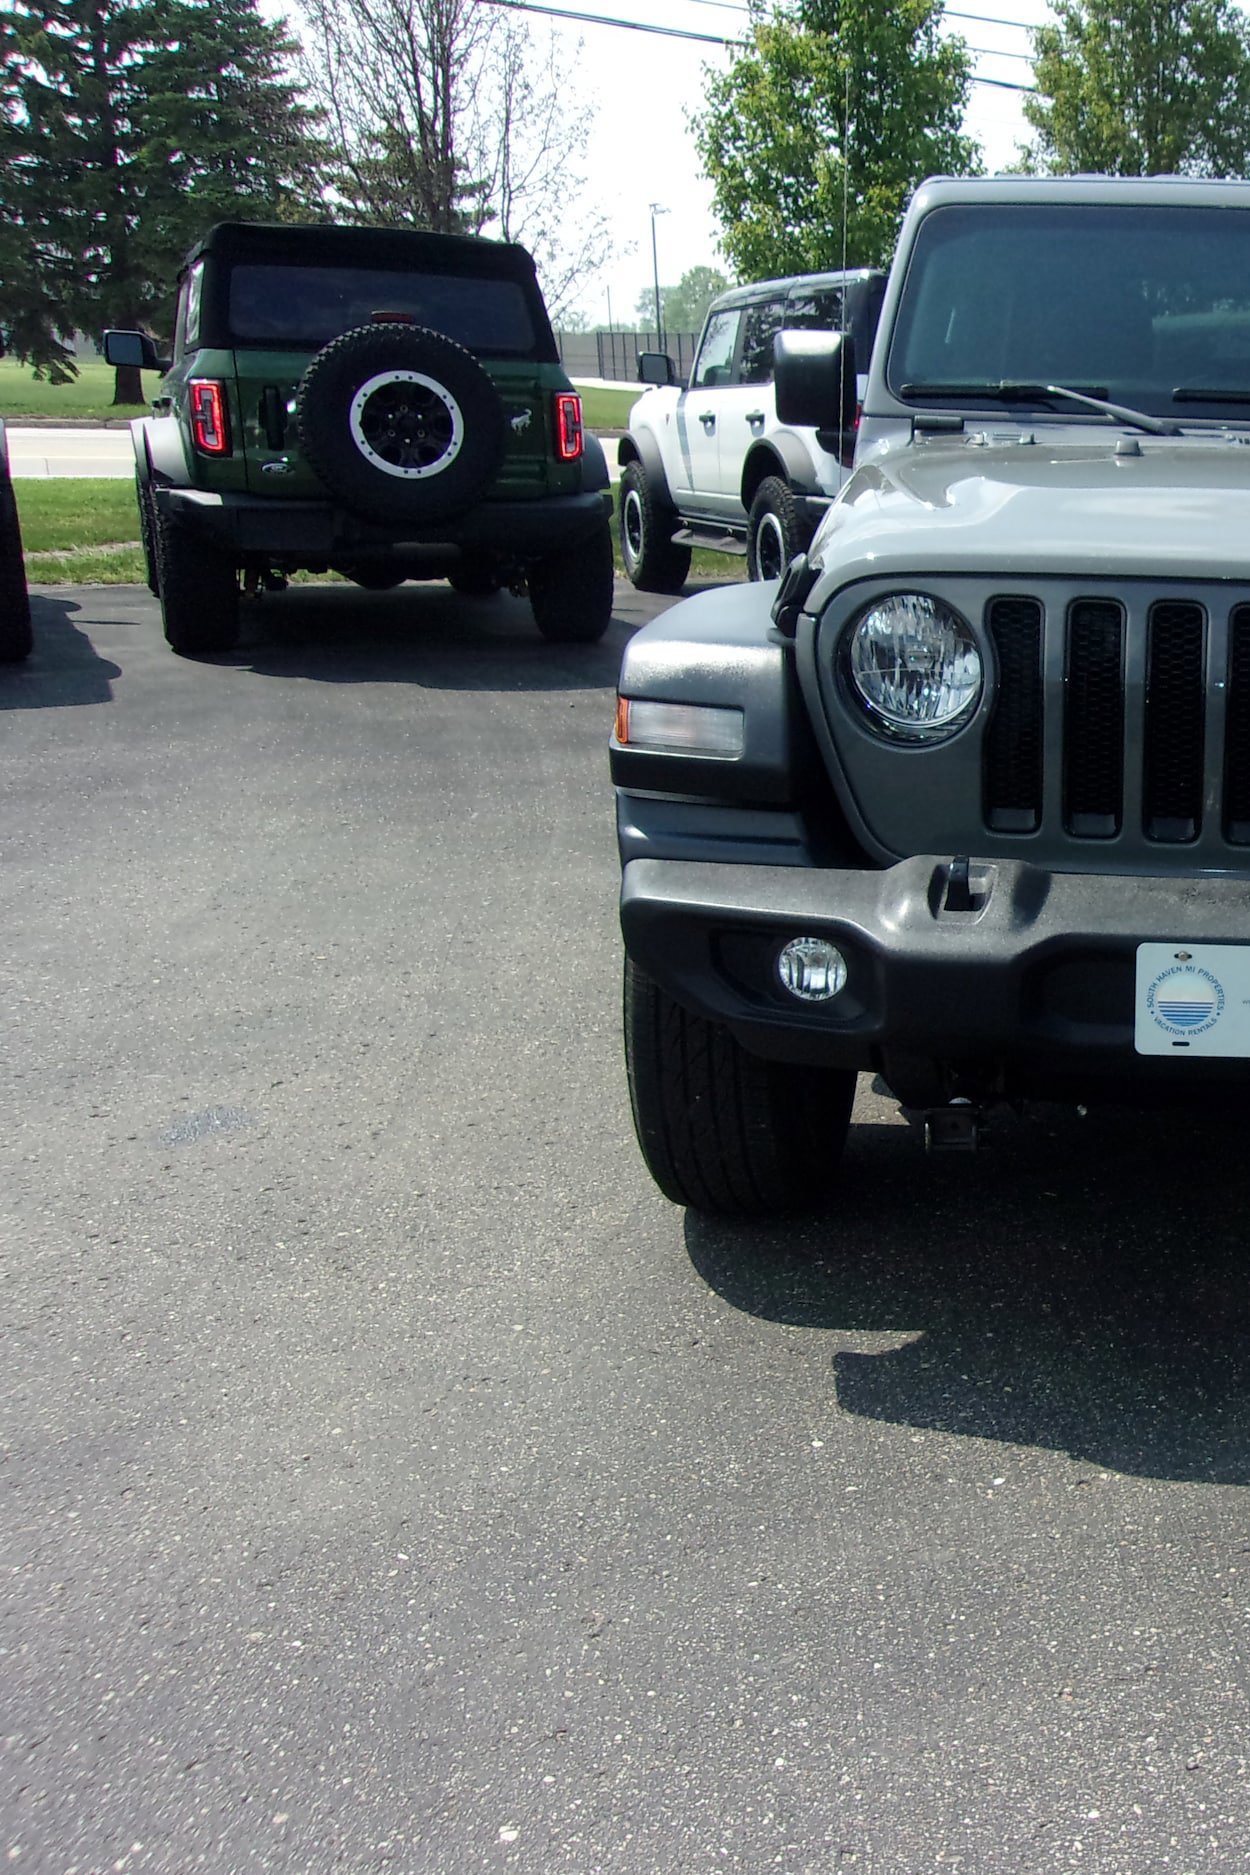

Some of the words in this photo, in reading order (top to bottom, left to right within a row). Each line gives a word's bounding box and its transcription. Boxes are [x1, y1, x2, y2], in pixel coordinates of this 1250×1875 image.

[1146, 982, 1158, 1008] SOUTH
[1155, 965, 1182, 983] HAVEN
[1185, 965, 1196, 973] MI
[1197, 968, 1225, 1010] PROPERTIES
[1154, 1016, 1185, 1036] VACATION
[1188, 1017, 1217, 1036] RENTALS
